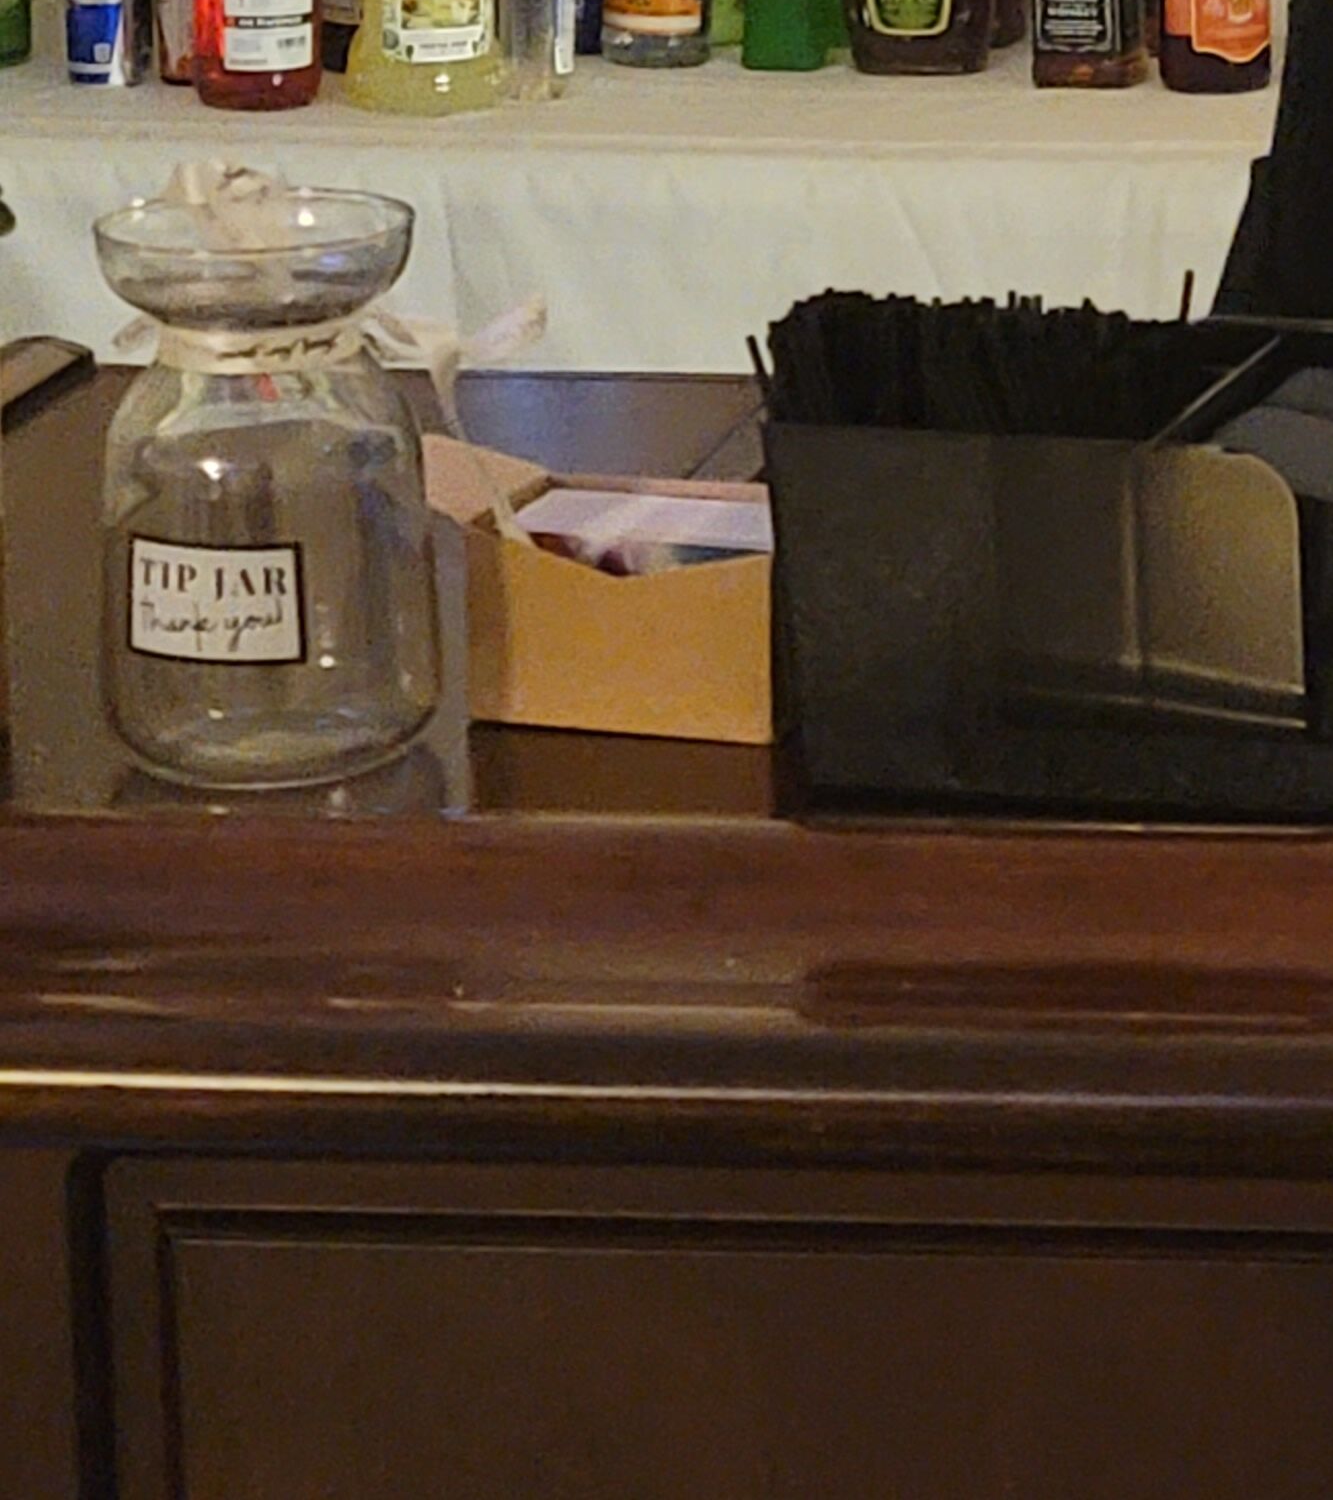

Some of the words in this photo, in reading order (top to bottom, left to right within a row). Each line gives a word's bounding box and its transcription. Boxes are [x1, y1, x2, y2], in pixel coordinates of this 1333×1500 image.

[140, 556, 198, 593] TIP
[214, 566, 287, 601] JAR
[140, 600, 217, 652] Thank
